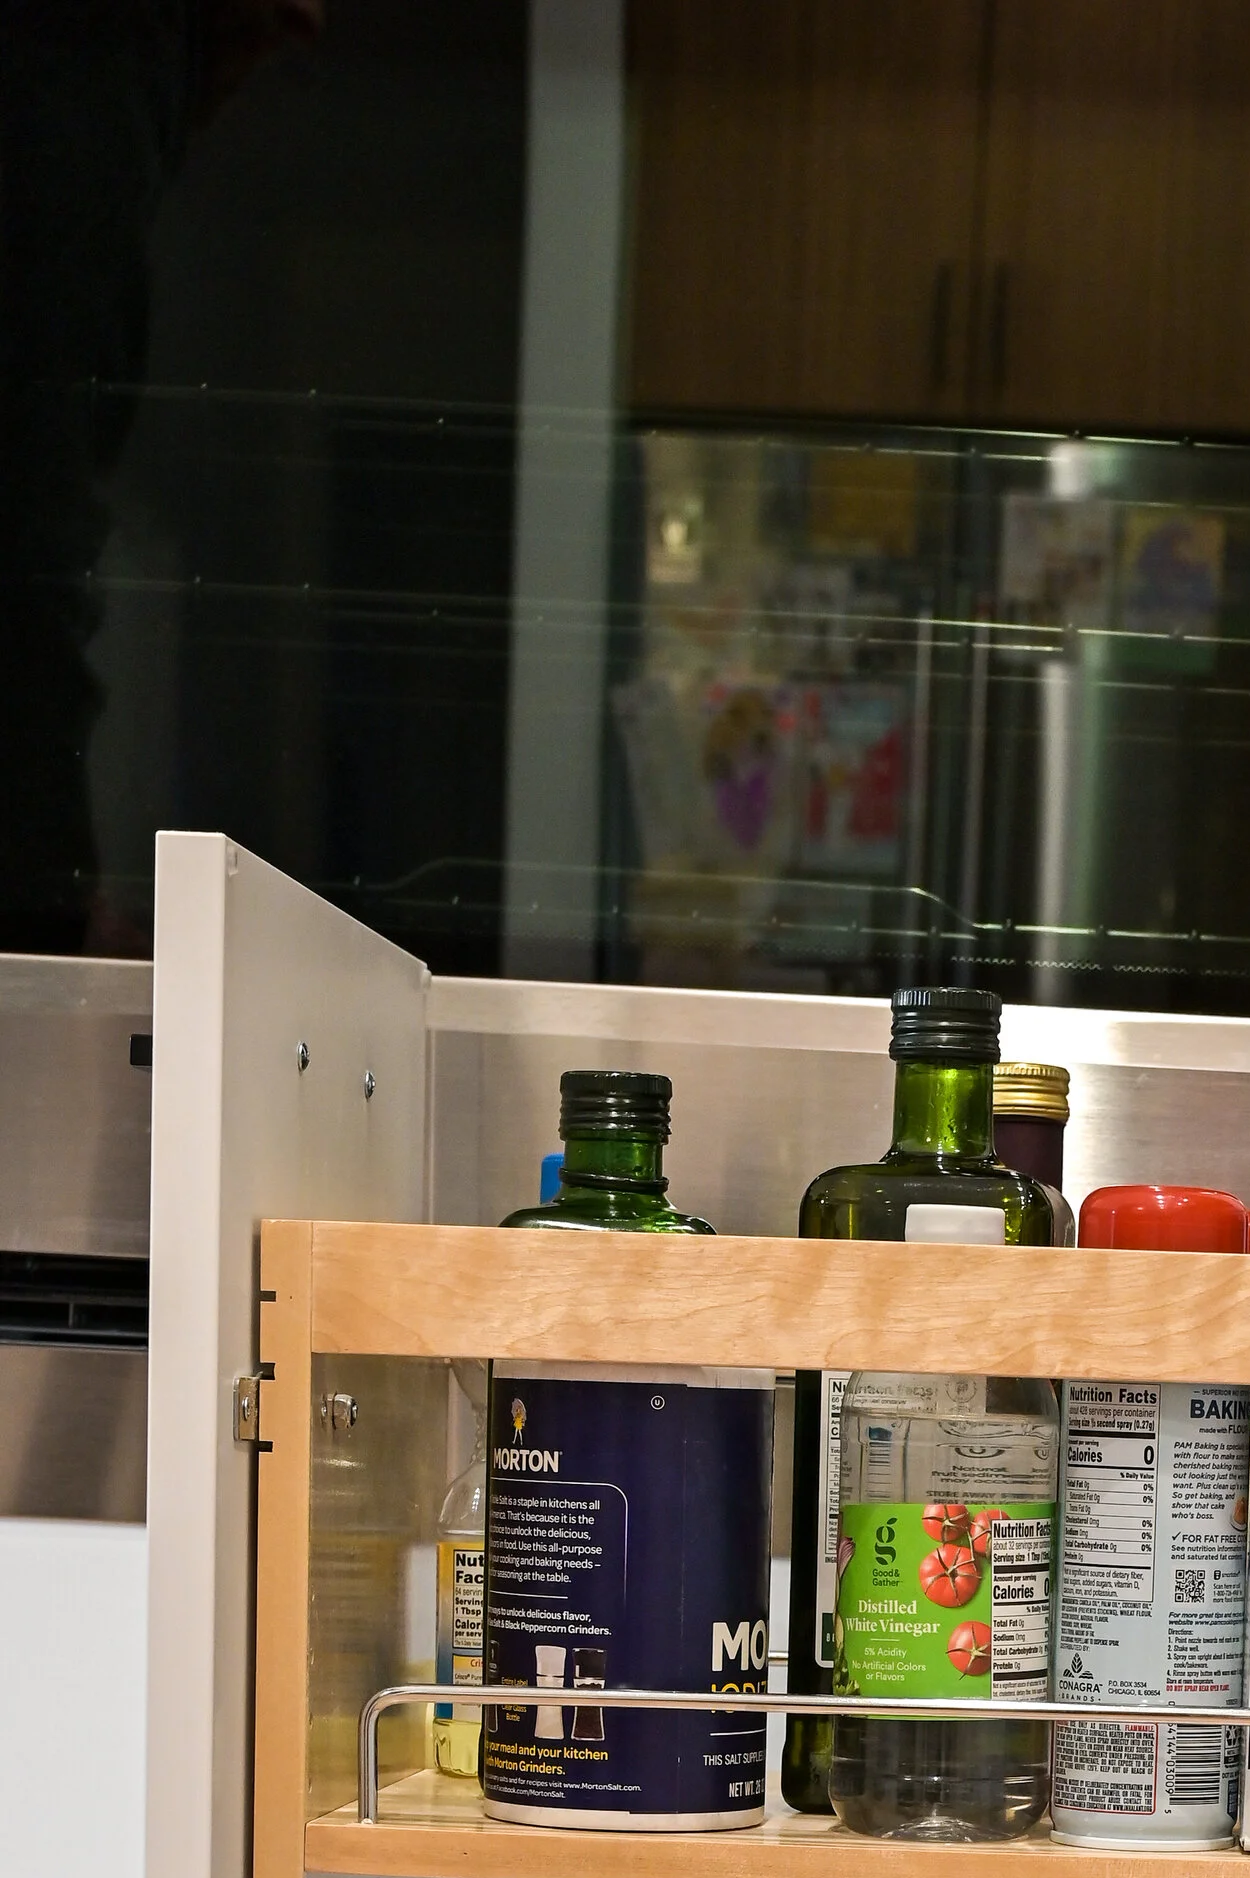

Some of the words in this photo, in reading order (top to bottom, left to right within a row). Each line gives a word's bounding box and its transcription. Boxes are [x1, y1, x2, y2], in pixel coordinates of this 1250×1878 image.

[1069, 1386, 1113, 1403] Nutrition
[1119, 1388, 1157, 1404] Facts
[1124, 1408, 1156, 1418] container
[1173, 1441, 1193, 1450] PAM
[1194, 1442, 1219, 1451] Baking
[493, 1447, 559, 1473] MORTON
[1067, 1446, 1103, 1463] Calories
[1143, 1445, 1155, 1465] 0
[548, 1498, 588, 1510] kitchens
[589, 1499, 600, 1510] all
[526, 1511, 560, 1524] because
[561, 1513, 568, 1524] it
[569, 1514, 576, 1524] is
[578, 1514, 595, 1525] the
[993, 1522, 1034, 1539] Nutrition
[1182, 1534, 1202, 1543] FOR
[1203, 1534, 1219, 1543] FAT
[1220, 1535, 1237, 1543] FREE
[548, 1543, 603, 1556] all-purpose
[872, 1578, 900, 1587] Gather
[993, 1584, 1034, 1601] Calories
[461, 1607, 482, 1617] Tbsp
[858, 1600, 917, 1615] Distilled
[562, 1610, 592, 1623] flavor,
[520, 1622, 567, 1634] Peppercorn
[568, 1624, 612, 1636] Grinders.
[846, 1617, 878, 1632] White
[879, 1619, 941, 1637] Vinegar
[864, 1647, 876, 1656] 5%
[877, 1647, 907, 1659] Acidity
[852, 1660, 861, 1669] No
[862, 1661, 895, 1671] Artificial
[896, 1662, 926, 1671] Colors
[875, 1672, 905, 1682] Flavors
[1059, 1679, 1100, 1693] CONAGRA
[537, 1746, 562, 1760] your
[563, 1747, 609, 1761] kitchen
[703, 1754, 723, 1767] THIS
[724, 1753, 742, 1766] SALT
[519, 1761, 566, 1776] Grinders.
[729, 1782, 744, 1798] NET
